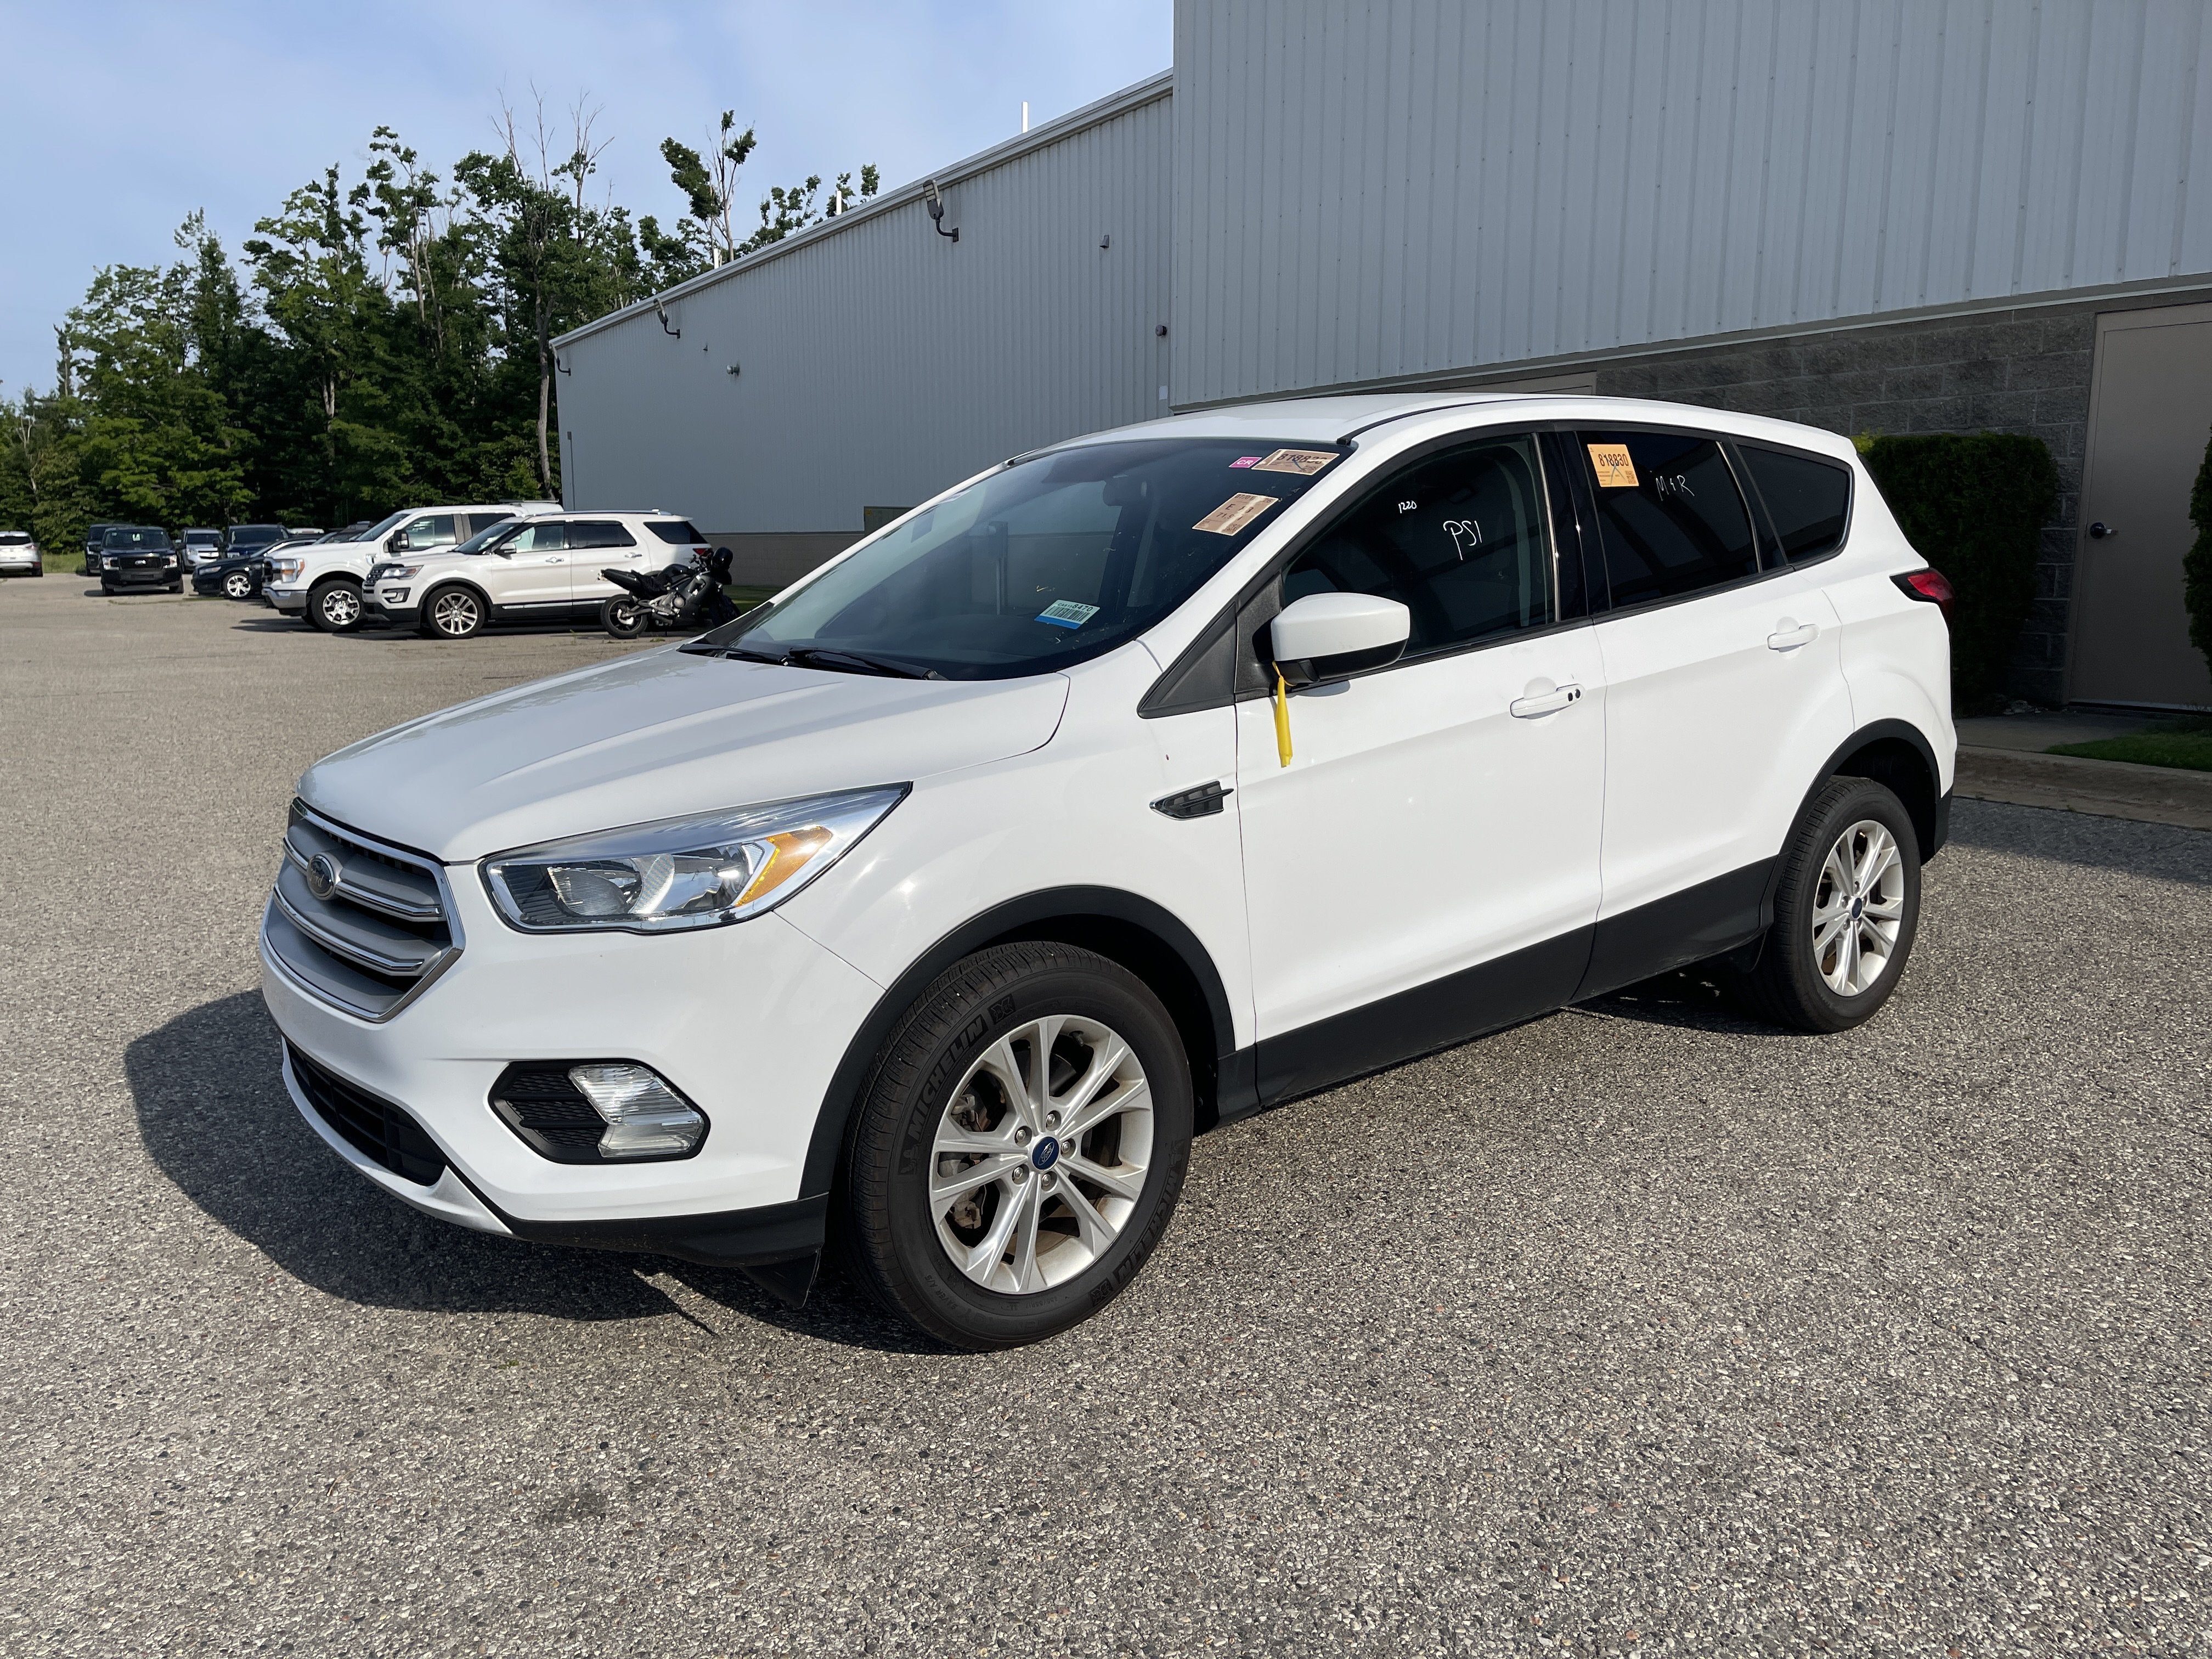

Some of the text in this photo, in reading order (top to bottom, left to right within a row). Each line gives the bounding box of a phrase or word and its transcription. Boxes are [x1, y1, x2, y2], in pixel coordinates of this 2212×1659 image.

[1598, 454, 1629, 466] 818830
[1398, 500, 1417, 514] 1220
[1443, 521, 1482, 561] PSI
[908, 1016, 985, 1141] MICHELIN
